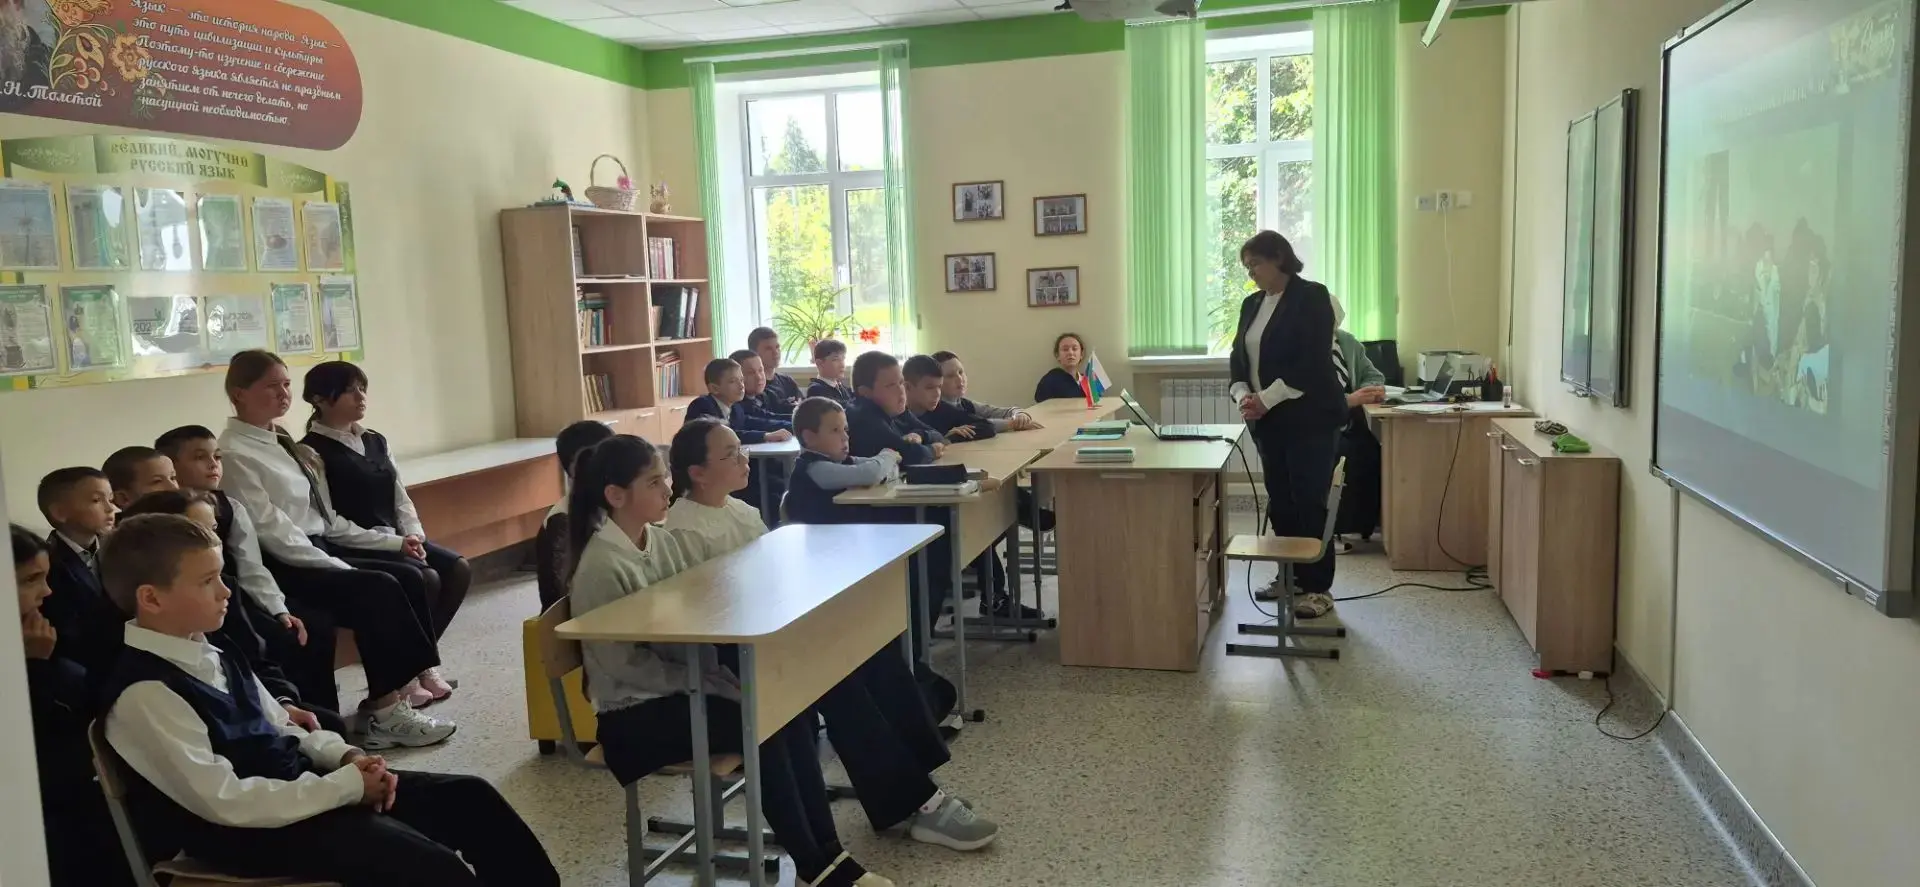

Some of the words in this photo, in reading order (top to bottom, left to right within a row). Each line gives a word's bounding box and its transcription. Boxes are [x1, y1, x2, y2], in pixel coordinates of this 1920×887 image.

[132, 17, 157, 30] это
[160, 24, 190, 37] путь
[193, 31, 263, 53] цивилизации
[265, 46, 272, 54] и
[274, 46, 324, 65] культуры
[187, 11, 209, 22] это
[212, 17, 259, 34] история
[300, 33, 328, 49] Язык
[135, 34, 215, 60] Поэтому-то
[217, 53, 262, 68] изучение
[264, 63, 272, 71] и
[273, 62, 325, 81] сбережение
[137, 57, 190, 74] русского
[192, 65, 228, 80] языка
[230, 72, 280, 90] является
[281, 83, 293, 92] не
[294, 85, 342, 100] праздным
[139, 77, 201, 94] занятием
[202, 86, 220, 97] от
[221, 90, 255, 102] нечего
[256, 91, 295, 110] делать,
[297, 102, 309, 111] но
[141, 95, 200, 112] насущной
[130, 158, 195, 175] РУССКИЙ
[199, 164, 237, 179] ЯЗЫК
